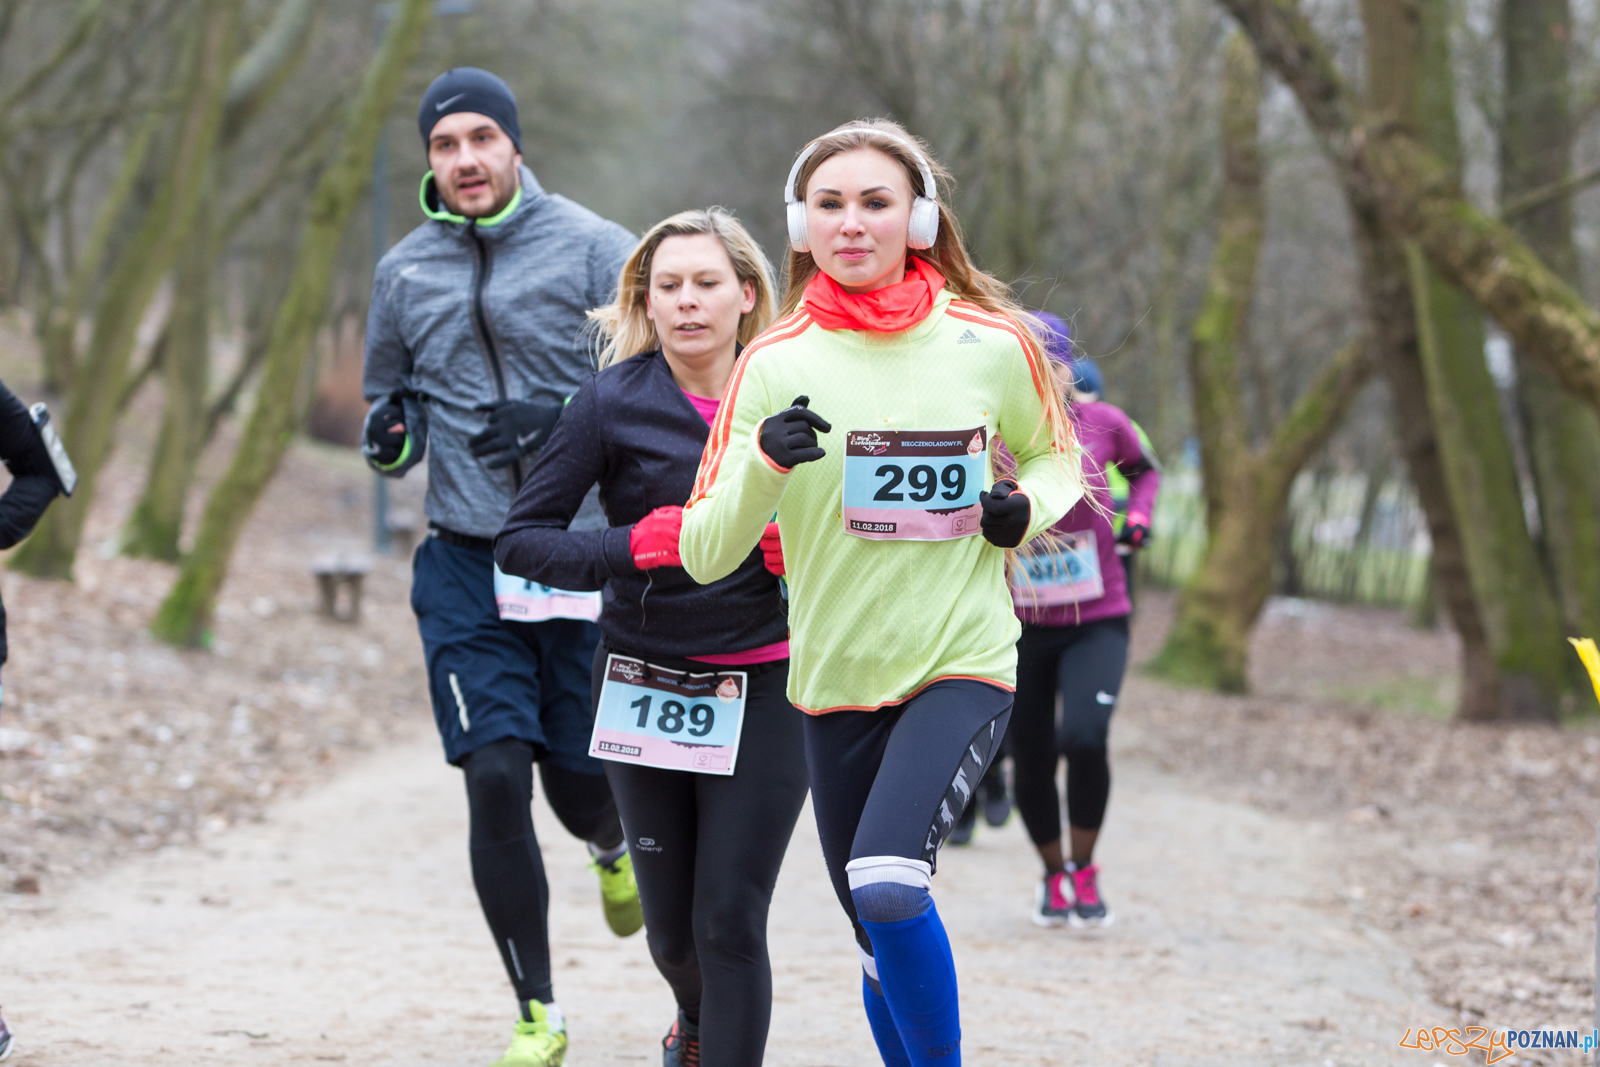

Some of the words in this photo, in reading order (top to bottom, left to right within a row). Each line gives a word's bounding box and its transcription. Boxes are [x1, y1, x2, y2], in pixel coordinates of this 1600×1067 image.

[872, 464, 966, 502] 299
[852, 521, 894, 532] 11.02.2018
[630, 695, 715, 737] 189
[600, 742, 640, 756] 11.02.2018
